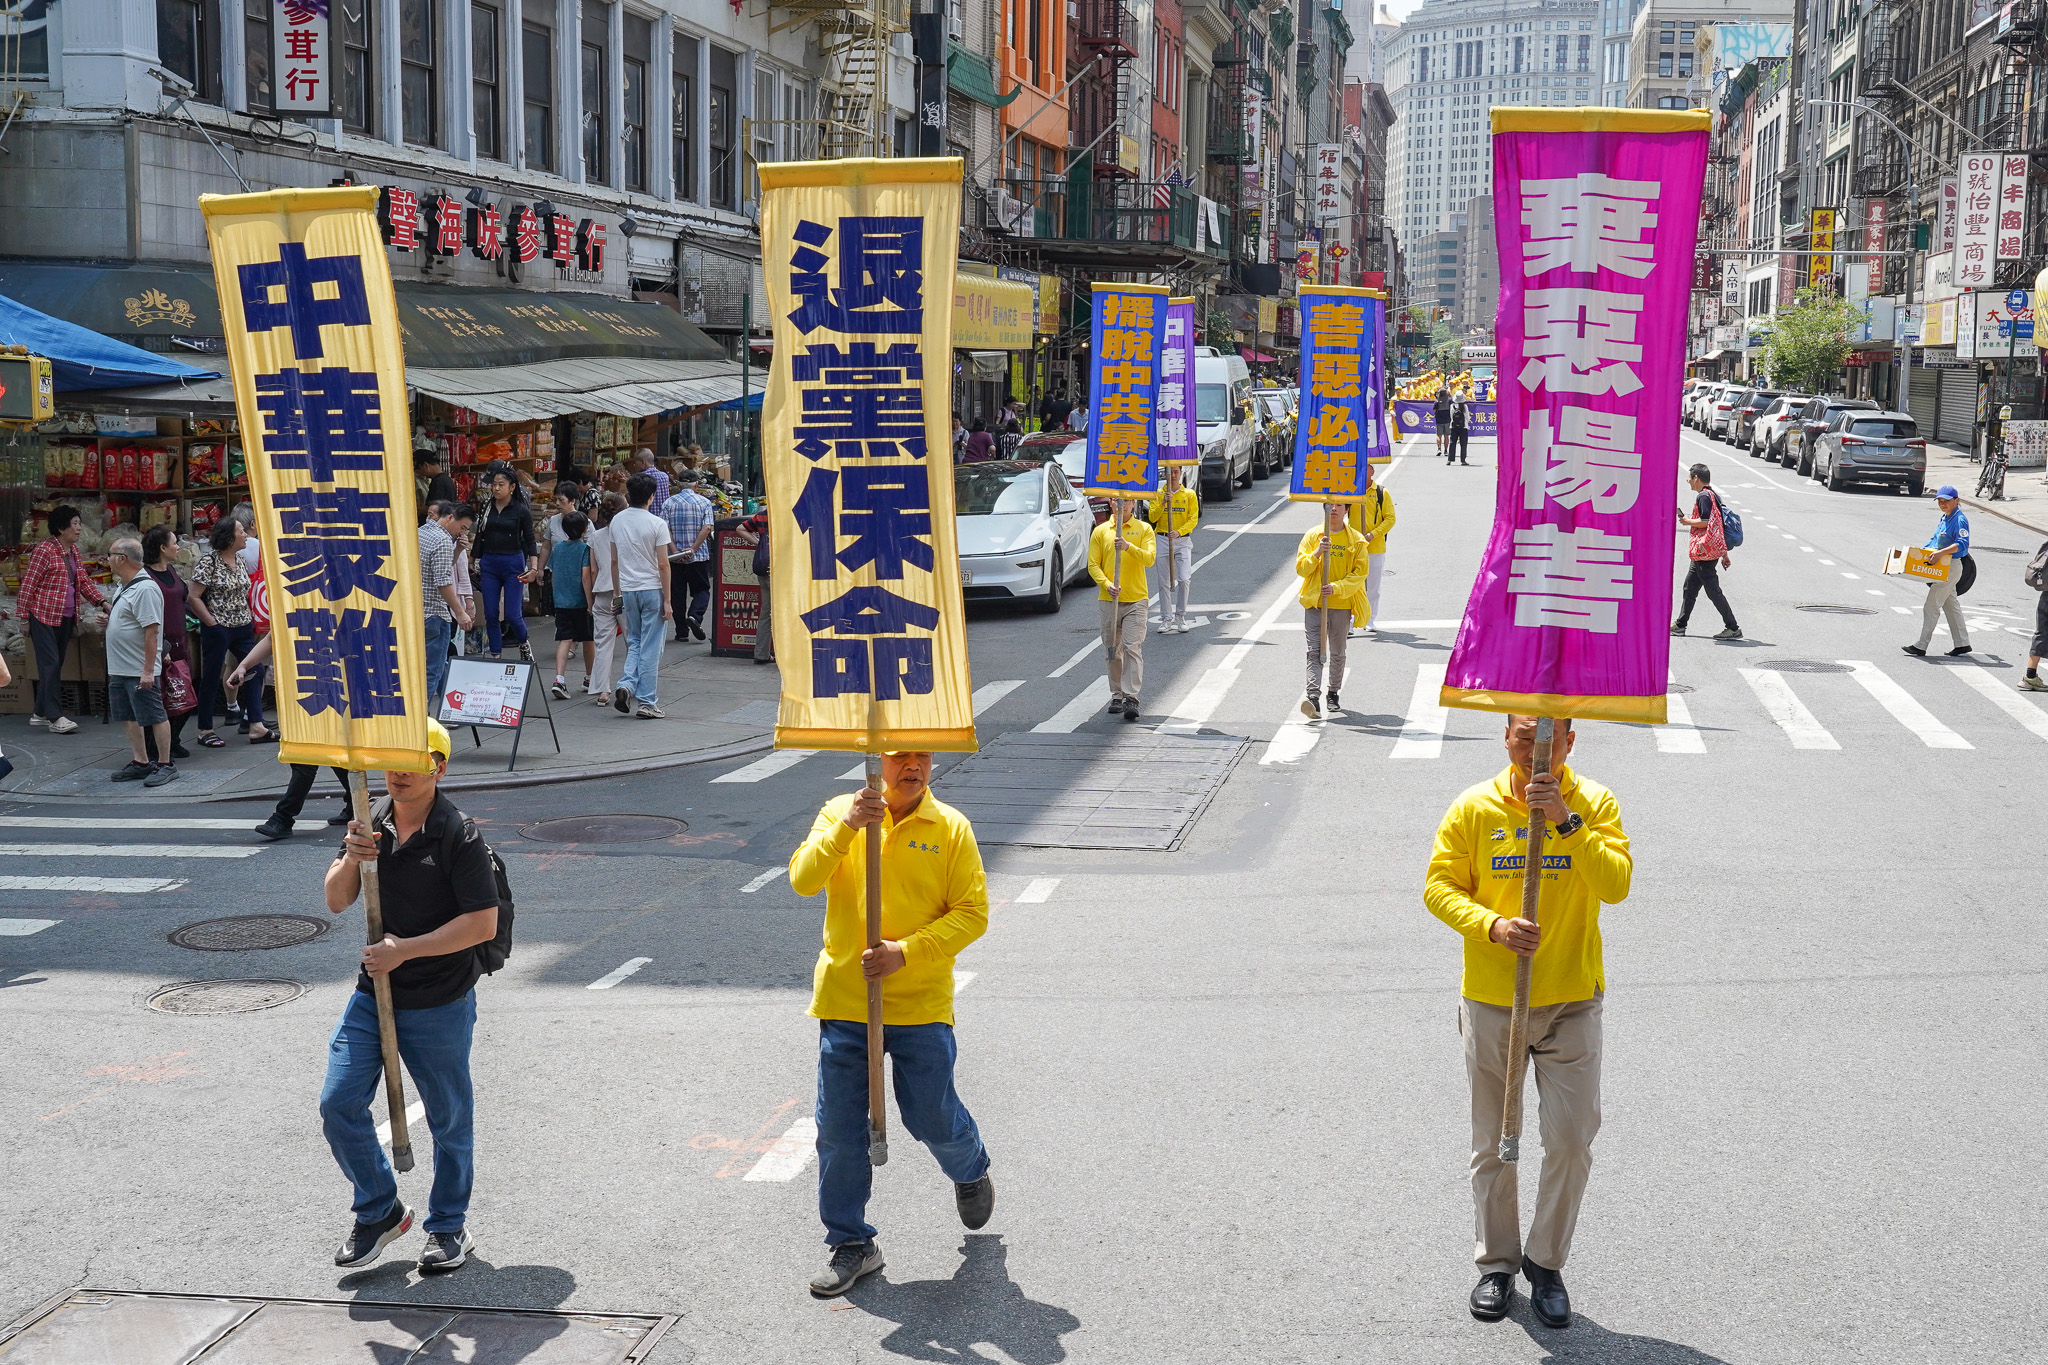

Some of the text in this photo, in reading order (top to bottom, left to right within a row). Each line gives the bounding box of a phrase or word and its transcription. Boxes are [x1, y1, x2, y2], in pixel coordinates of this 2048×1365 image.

[1095, 294, 1154, 485] 擺脫中共暴政
[1303, 303, 1365, 493] 善惡必報
[236, 242, 407, 718] 中華蒙難
[787, 216, 940, 701] 退黨保命
[723, 590, 745, 600] SHOW
[723, 601, 759, 618] LOVE
[1911, 564, 1943, 577] LEMONS
[1495, 858, 1567, 867] FALU AFA
